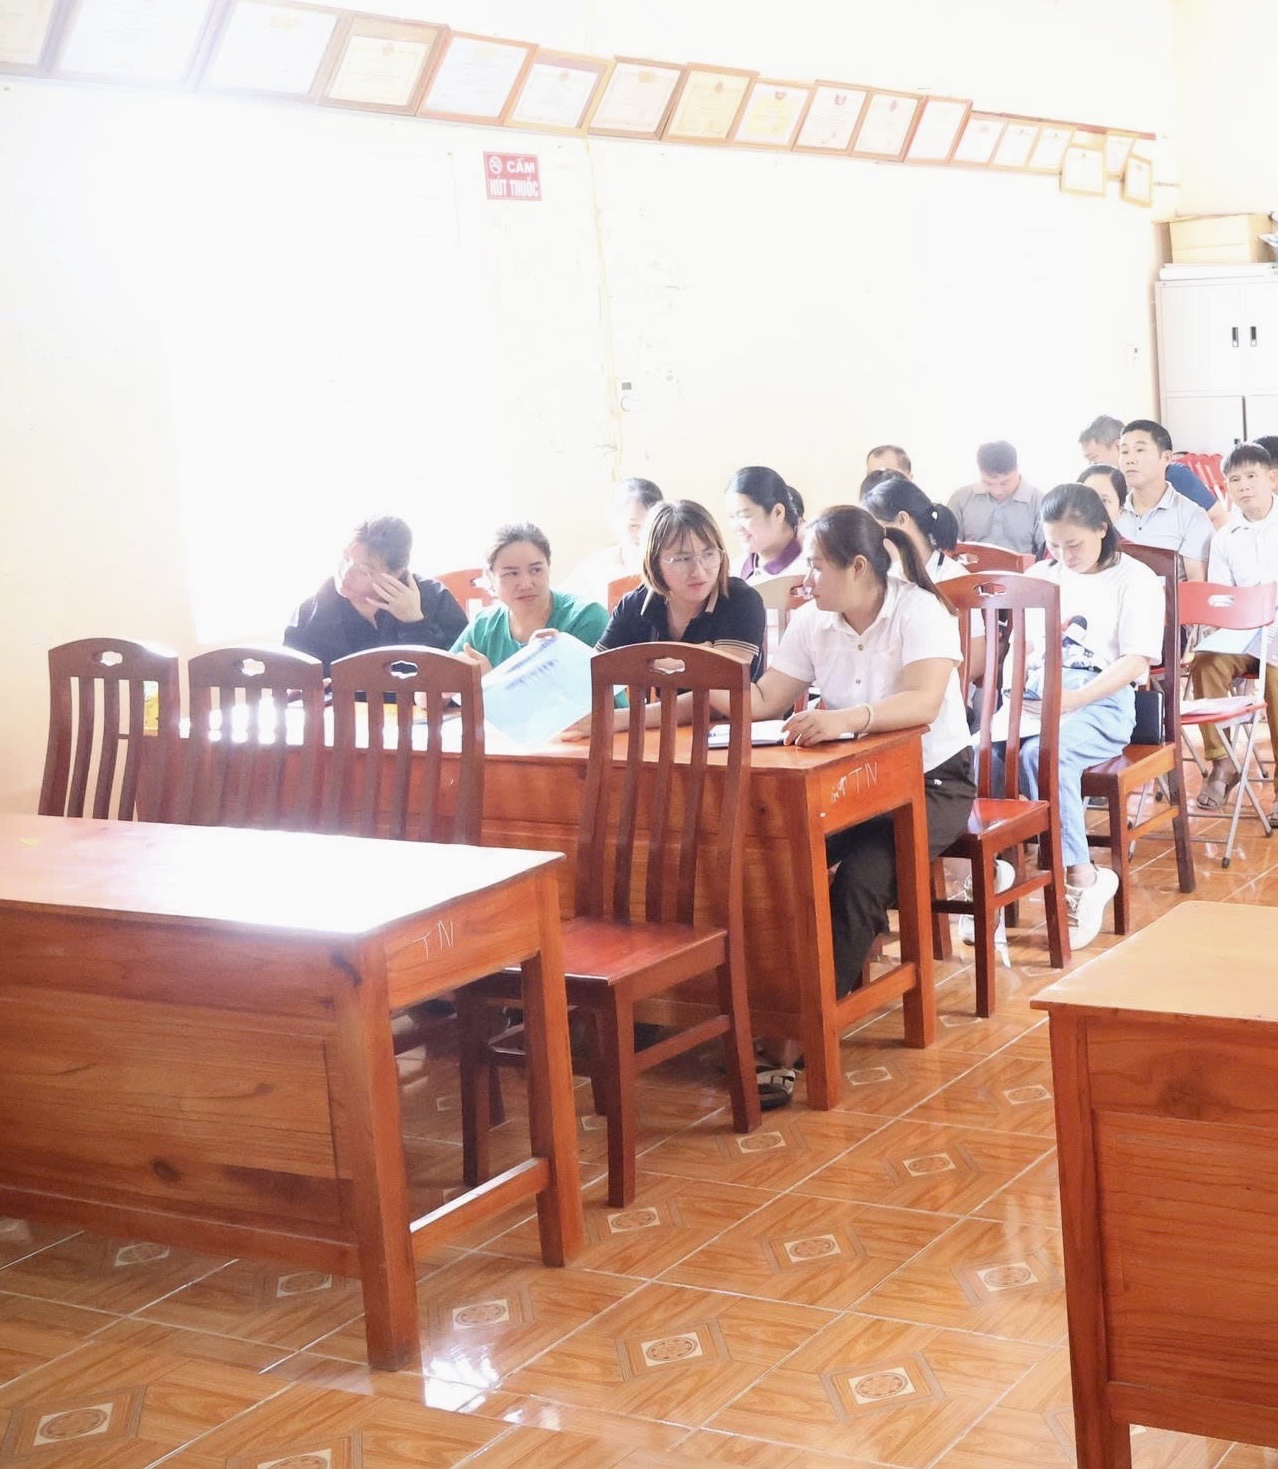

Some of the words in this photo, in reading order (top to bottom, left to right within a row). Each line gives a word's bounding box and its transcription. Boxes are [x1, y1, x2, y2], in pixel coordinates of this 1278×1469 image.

[506, 156, 535, 174] CẤM
[490, 175, 507, 196] HÚT
[509, 174, 540, 198] THUỐC
[849, 761, 878, 794] TN
[412, 920, 454, 960] TN
